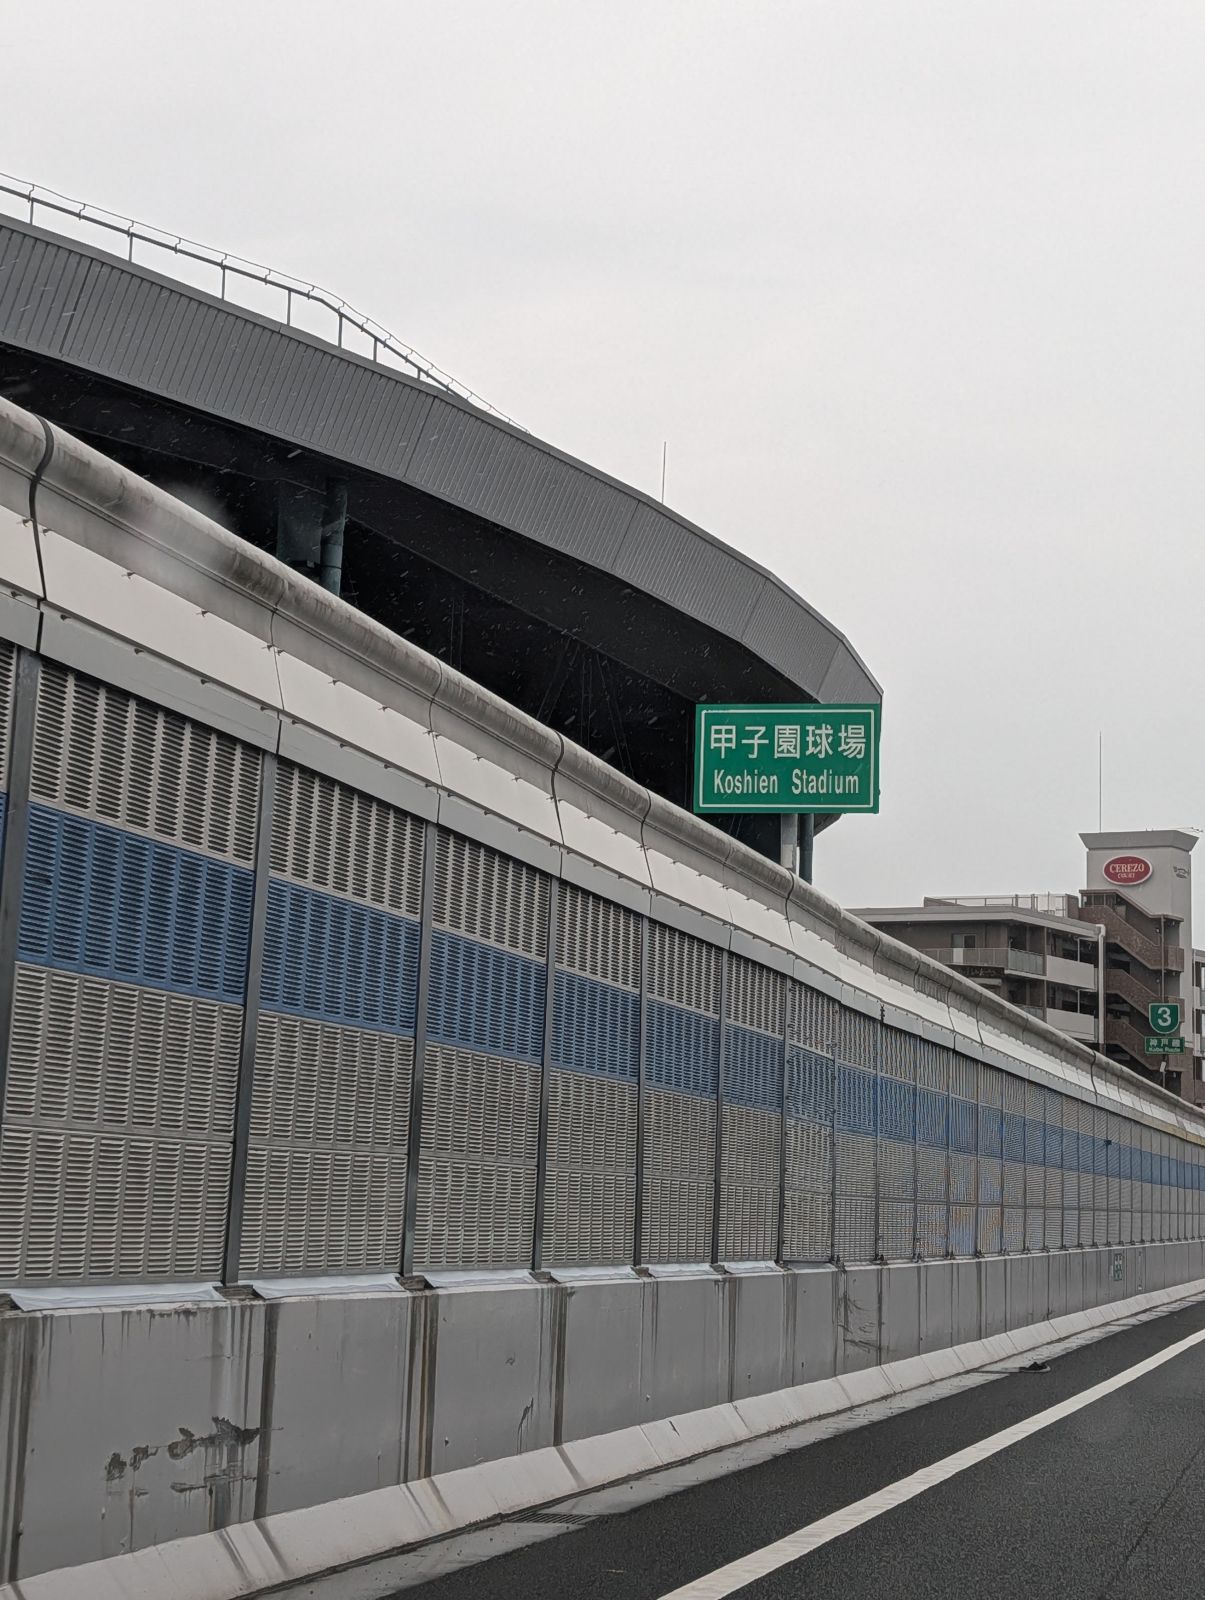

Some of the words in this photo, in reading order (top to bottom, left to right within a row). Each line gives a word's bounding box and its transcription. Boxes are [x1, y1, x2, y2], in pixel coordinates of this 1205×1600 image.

[710, 724, 866, 759] 甲子園球場
[715, 769, 778, 794] Koshien
[792, 768, 859, 795] Stadium
[1109, 863, 1145, 873] CEREZO
[1157, 1007, 1172, 1026] 3
